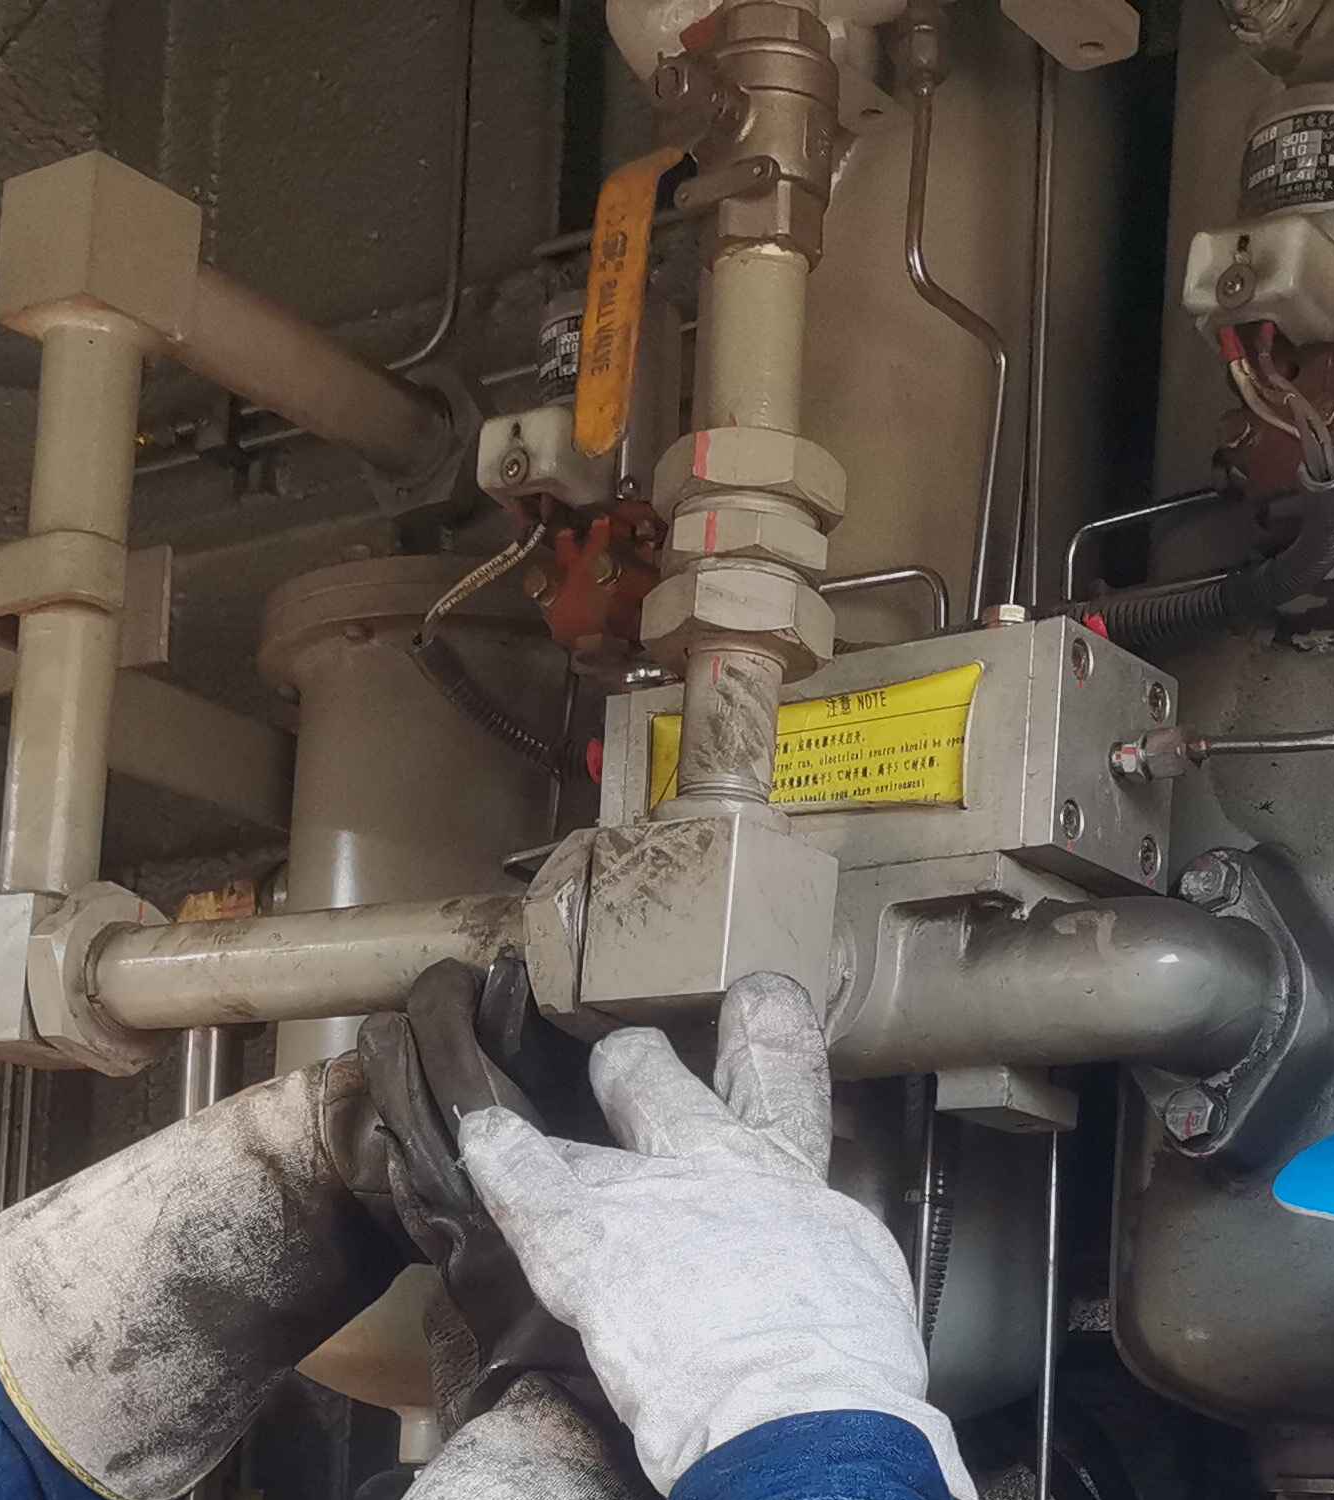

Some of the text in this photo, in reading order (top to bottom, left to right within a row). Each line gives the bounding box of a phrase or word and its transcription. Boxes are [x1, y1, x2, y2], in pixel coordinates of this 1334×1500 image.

[826, 690, 888, 720] 注意 NOTE
[900, 738, 928, 753] should
